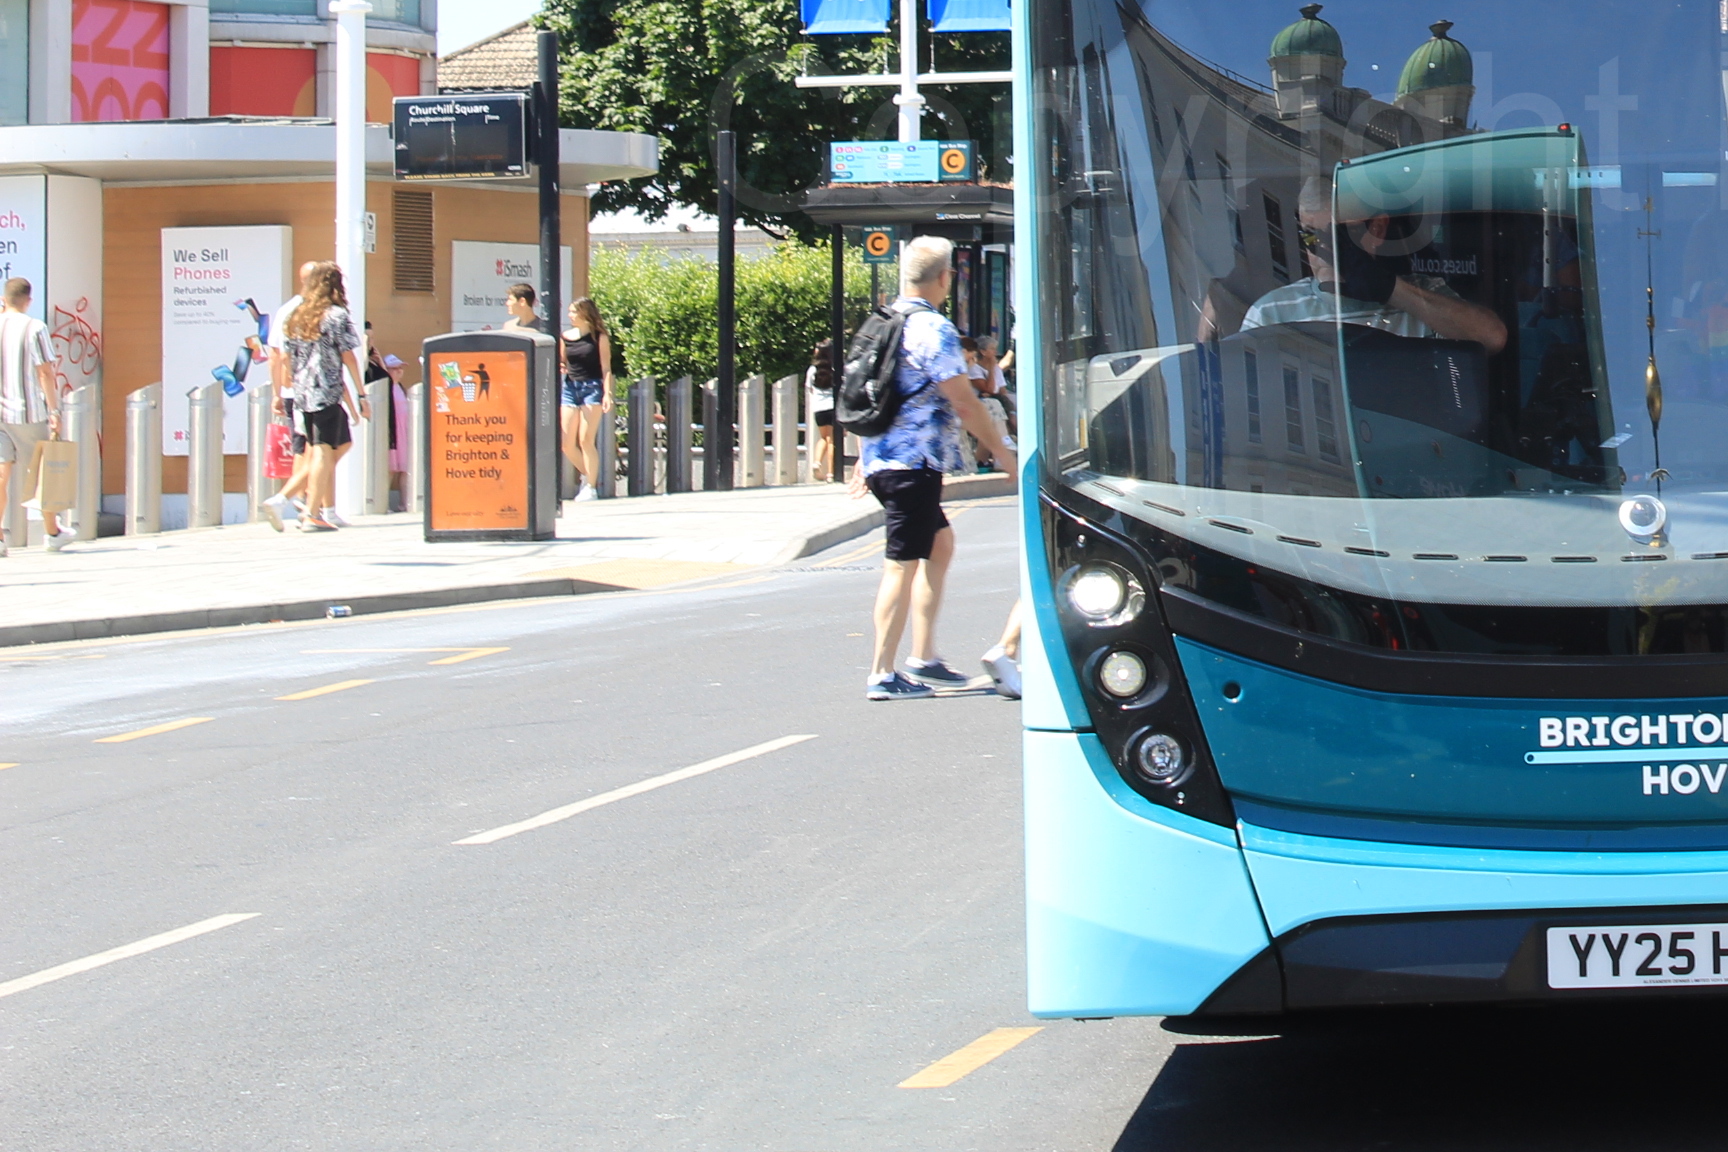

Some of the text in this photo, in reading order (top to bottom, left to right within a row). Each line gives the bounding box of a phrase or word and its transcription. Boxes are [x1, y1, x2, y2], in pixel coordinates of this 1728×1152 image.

[408, 102, 490, 116] Churchill Square
[173, 248, 229, 263] We Sell
[173, 266, 231, 280] Phones
[503, 259, 533, 278] iSmash
[173, 286, 227, 295] Refurbished
[173, 298, 207, 307] devices
[463, 294, 484, 306] Broken
[484, 294, 493, 306] for
[445, 413, 507, 427] Thank you
[445, 431, 513, 445] for keeping
[445, 449, 510, 464] Brighton &
[445, 466, 502, 480] Hove tidy
[1569, 930, 1696, 978] YY25
